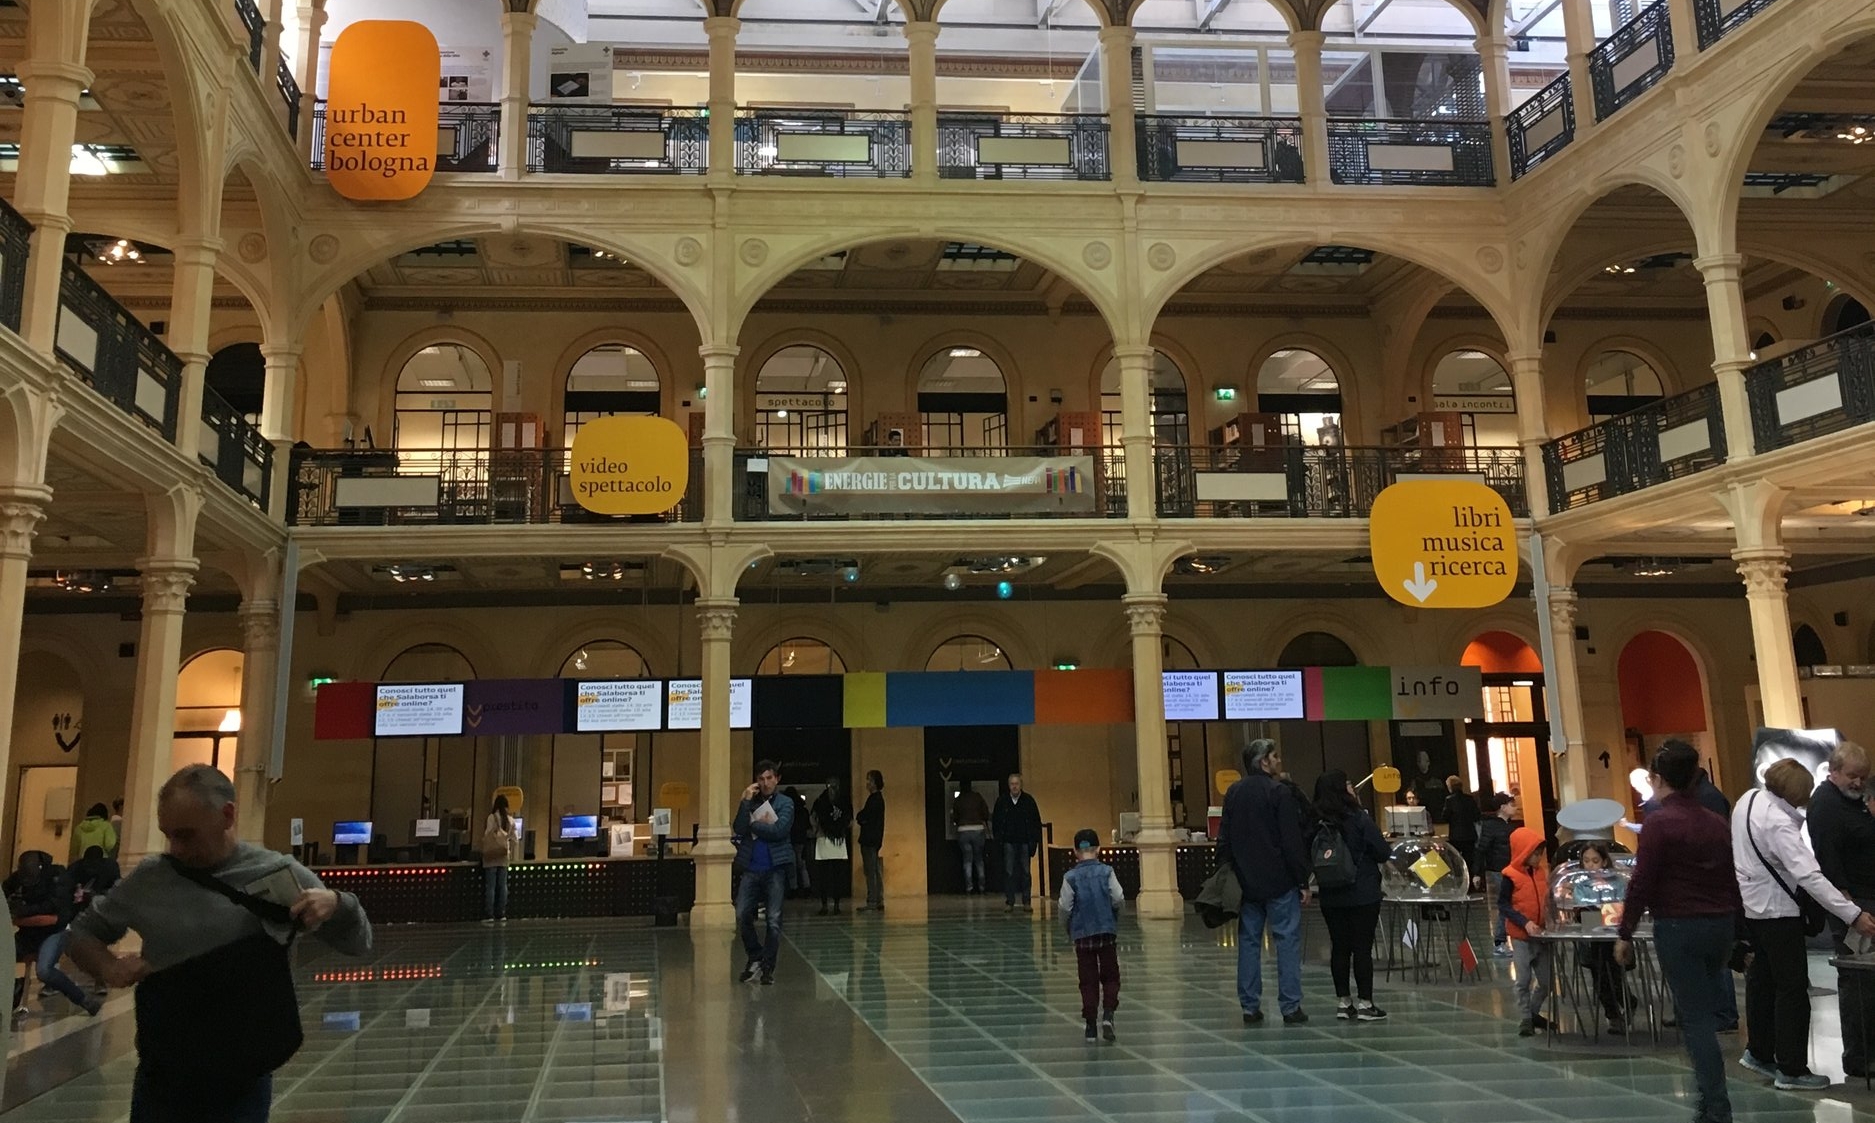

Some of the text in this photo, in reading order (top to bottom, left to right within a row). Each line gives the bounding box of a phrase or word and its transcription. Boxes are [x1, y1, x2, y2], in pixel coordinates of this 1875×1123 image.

[332, 103, 406, 124] urban
[330, 130, 411, 148] center
[329, 150, 430, 177] bologna
[767, 396, 835, 408] spettacoo
[1462, 400, 1511, 409] incontri
[580, 457, 628, 474] video
[579, 475, 672, 498] spettacolo
[824, 472, 888, 490] ENERGIE
[898, 472, 1001, 490] CULTURA
[1452, 506, 1502, 528] libri
[1422, 531, 1505, 552] musica
[1430, 555, 1507, 576] ricerca
[1397, 676, 1459, 696] info
